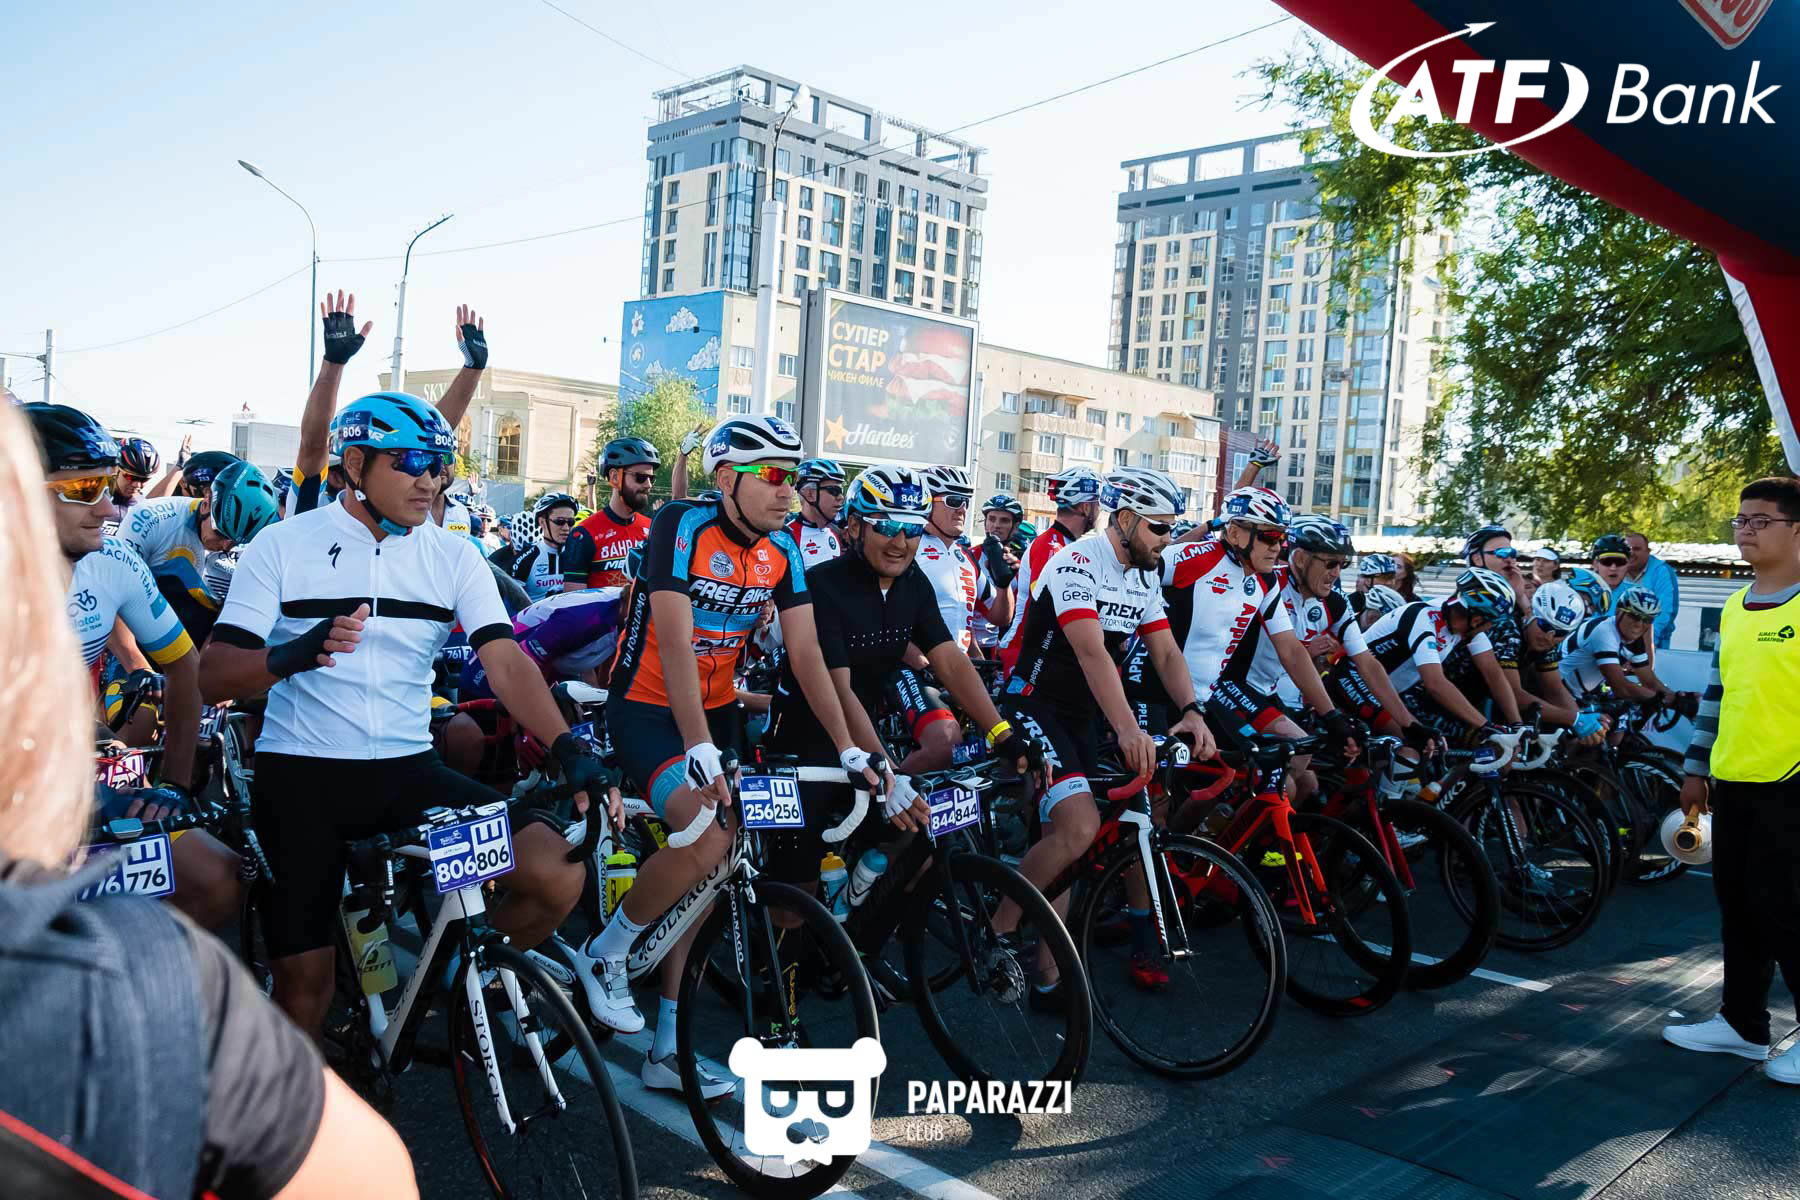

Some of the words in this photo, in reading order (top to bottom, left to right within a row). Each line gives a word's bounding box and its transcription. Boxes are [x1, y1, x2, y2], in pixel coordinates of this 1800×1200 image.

[832, 321, 889, 347] СУПЕР
[828, 343, 887, 372] СТАР
[424, 383, 448, 401] SKY
[342, 426, 361, 438] 806
[711, 441, 726, 454] 256
[900, 494, 919, 504] 844
[100, 545, 139, 573] RACING
[536, 577, 564, 587] Sunw
[689, 579, 738, 603] FREE
[1096, 600, 1145, 620] TREK
[1030, 658, 1044, 685] people
[1041, 629, 1054, 650] bikes
[1128, 643, 1149, 683] APPL
[745, 803, 774, 821] 256
[775, 804, 800, 820] 256
[932, 811, 956, 830] 844
[955, 803, 977, 821] 844
[436, 855, 477, 883] 806
[476, 844, 509, 872] 806
[127, 867, 167, 893] 776
[601, 861, 609, 919] COLNAGO
[729, 891, 745, 962] COLNAGO
[470, 999, 502, 1108] STORCK
